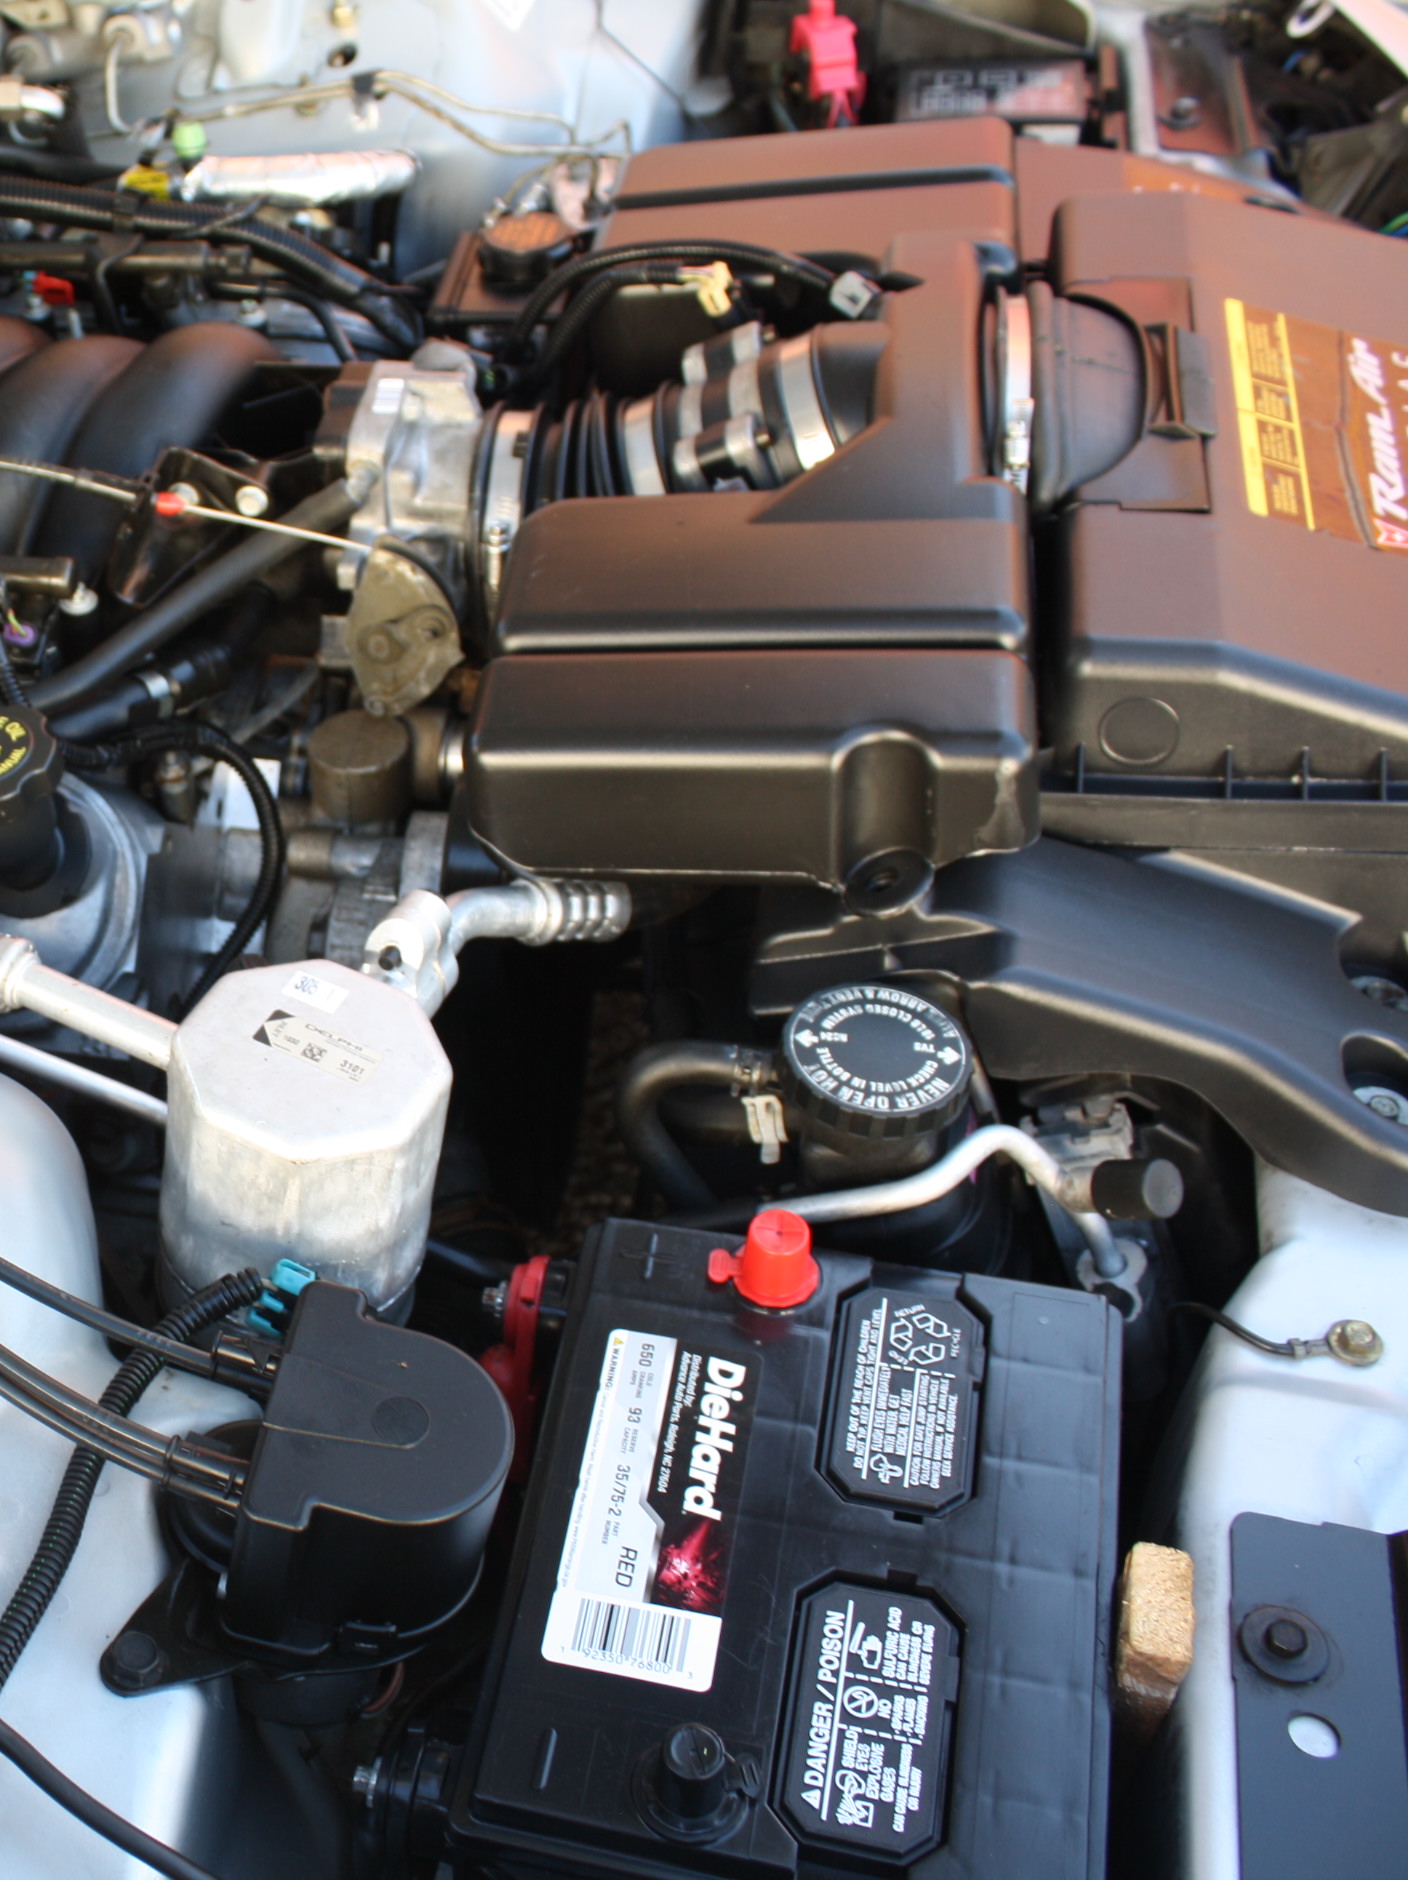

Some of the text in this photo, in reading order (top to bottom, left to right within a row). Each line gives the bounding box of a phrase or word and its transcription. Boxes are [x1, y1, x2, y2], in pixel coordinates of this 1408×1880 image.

[1348, 336, 1389, 405] Air
[1366, 403, 1408, 520] Ram
[5, 721, 26, 742] OIL
[864, 1004, 912, 1023] CLOSED
[877, 989, 928, 1013] ARROW
[821, 1004, 863, 1030] SYSTEM
[305, 1023, 363, 1052] DELPHI
[913, 1042, 935, 1053] TVS
[816, 1047, 939, 1092] CHECK LEVEL IN BOTTLE
[803, 1063, 950, 1109] NEVER OPEN HOT
[872, 1308, 882, 1328] LEVEL
[894, 1304, 925, 1318] RETURN
[870, 1329, 879, 1344] AND
[639, 1343, 655, 1367] 650
[866, 1344, 876, 1364] TIGHT
[605, 1348, 620, 1390] WARNING:
[630, 1370, 638, 1385] AMPS
[646, 1372, 654, 1386] COLD
[683, 1353, 702, 1407] Distributed by:
[864, 1366, 874, 1386] CAPS
[635, 1371, 646, 1398] CRANKING
[846, 1319, 871, 1452] KEEP OUT OF THE REACH OF CHILDREN
[862, 1386, 872, 1404] VENT
[918, 1375, 930, 1406] STARTING
[938, 1377, 950, 1411] AVAILABLE
[627, 1407, 642, 1423] 93
[859, 1405, 869, 1425] KEEP
[871, 1366, 891, 1452] FLUSH EYES IMMEDIATELY
[888, 1394, 900, 1409] GET
[916, 1405, 926, 1424] JUMP
[657, 1350, 692, 1493] Advance Auto Parts, Raleigh, NC 27604
[895, 1388, 913, 1456] MEDICAL HELP FAST
[935, 1424, 945, 1433] IF
[936, 1410, 946, 1425] NOT
[620, 1427, 631, 1454] CAPACITY
[629, 1428, 639, 1453] RESERVE
[682, 1356, 746, 1521] DieHard
[883, 1435, 896, 1453] WITH
[914, 1424, 925, 1441] SAFE
[920, 1379, 940, 1485] FOLLOW INSTRUCTIONS IN VEHICLE
[855, 1440, 866, 1456] NOT
[913, 1441, 923, 1456] FOR
[943, 1433, 955, 1460] SERVICE
[853, 1456, 864, 1469] DO
[941, 1460, 952, 1477] SEEK
[608, 1464, 631, 1516] 35/75-2
[602, 1520, 611, 1544] NUMBER
[612, 1521, 620, 1537] PART
[615, 1546, 638, 1588] RED
[817, 1609, 845, 1684] POISON
[881, 1606, 902, 1678] SULFURIC ACID
[907, 1620, 923, 1683] BLINDNESS OR
[919, 1624, 935, 1686] SEVERE BURNS
[583, 1648, 623, 1665] 92350
[631, 1657, 671, 1675] 76800
[895, 1632, 911, 1680] CAN CAUSE
[877, 1698, 892, 1719] NO
[803, 1701, 833, 1787] DANGER
[841, 1729, 858, 1769] SHIELD
[855, 1742, 871, 1772] EYES
[865, 1741, 885, 1800] EXPLOSIVE
[880, 1766, 896, 1803] GASES
[892, 1743, 913, 1832] CAN CAUSE BLINDNESS
[907, 1766, 922, 1811] OR INJURY
